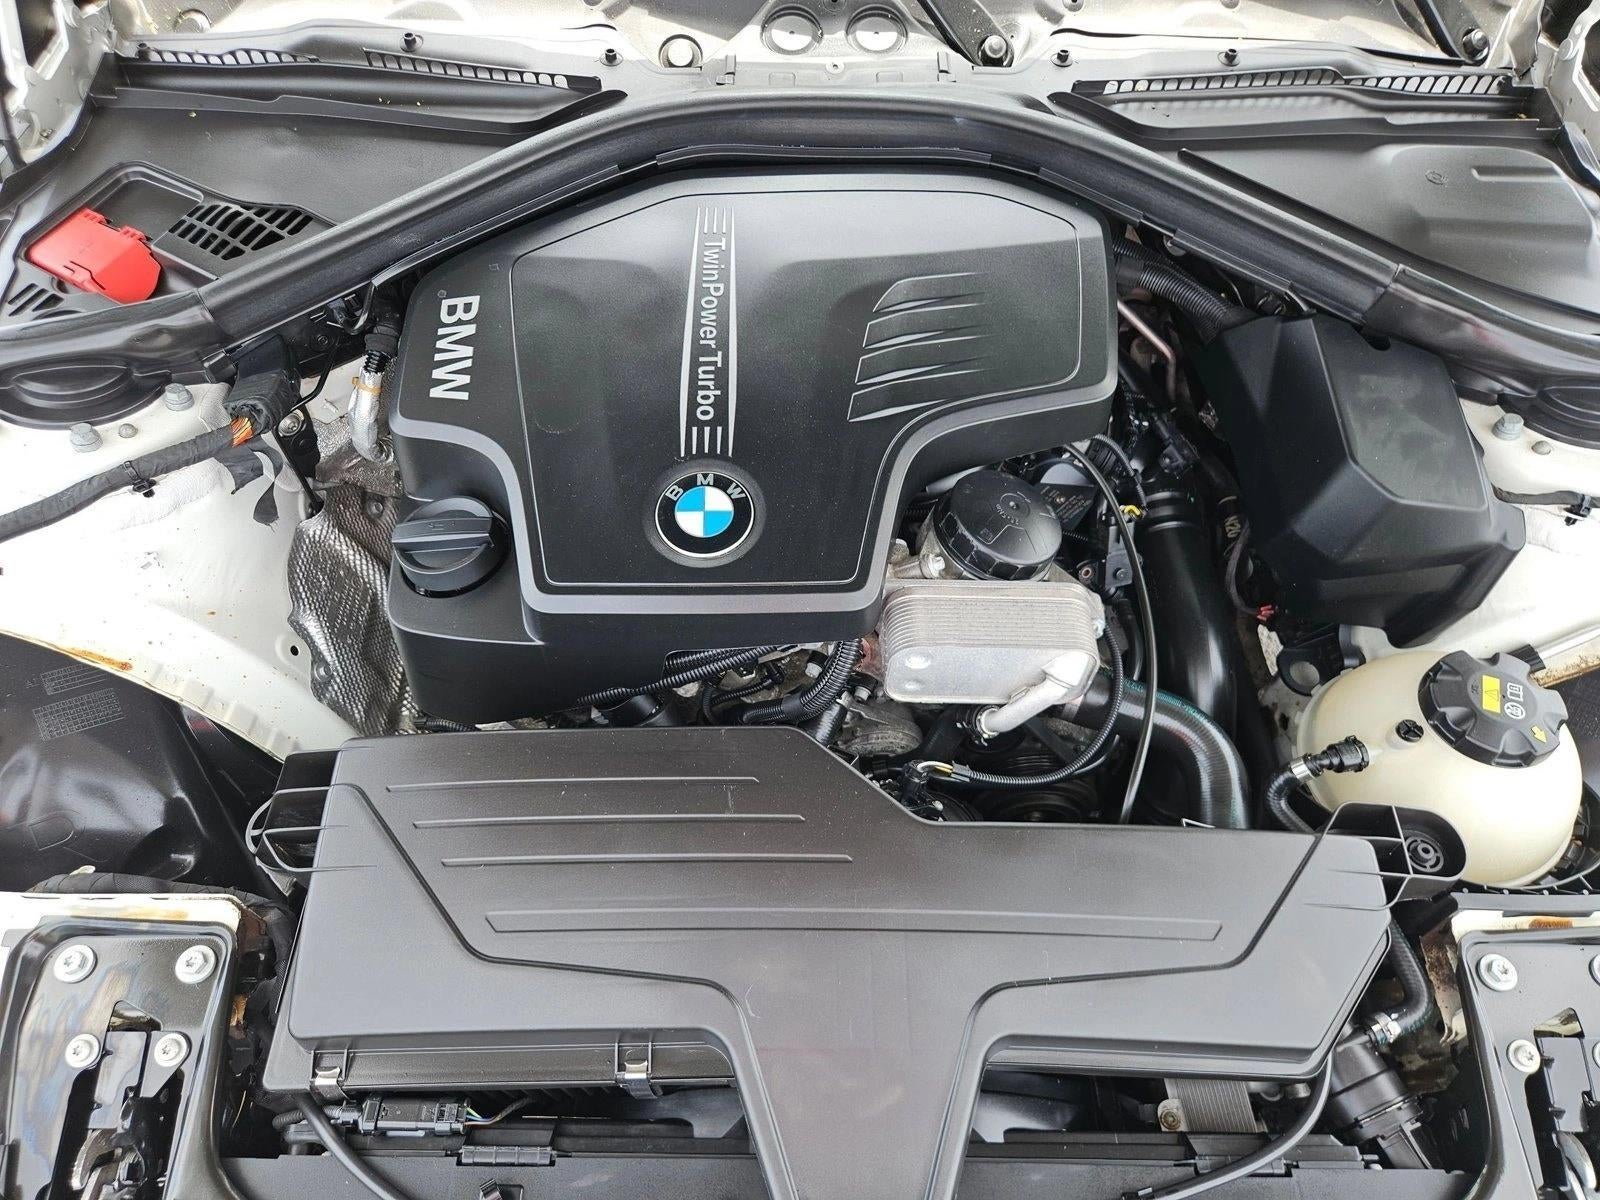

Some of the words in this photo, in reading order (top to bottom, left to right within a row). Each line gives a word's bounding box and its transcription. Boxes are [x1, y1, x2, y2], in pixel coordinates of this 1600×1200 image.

[698, 237, 726, 349] TwinPower
[429, 295, 480, 400] BMW
[696, 351, 723, 421] Turbo
[665, 473, 746, 501] BMW
